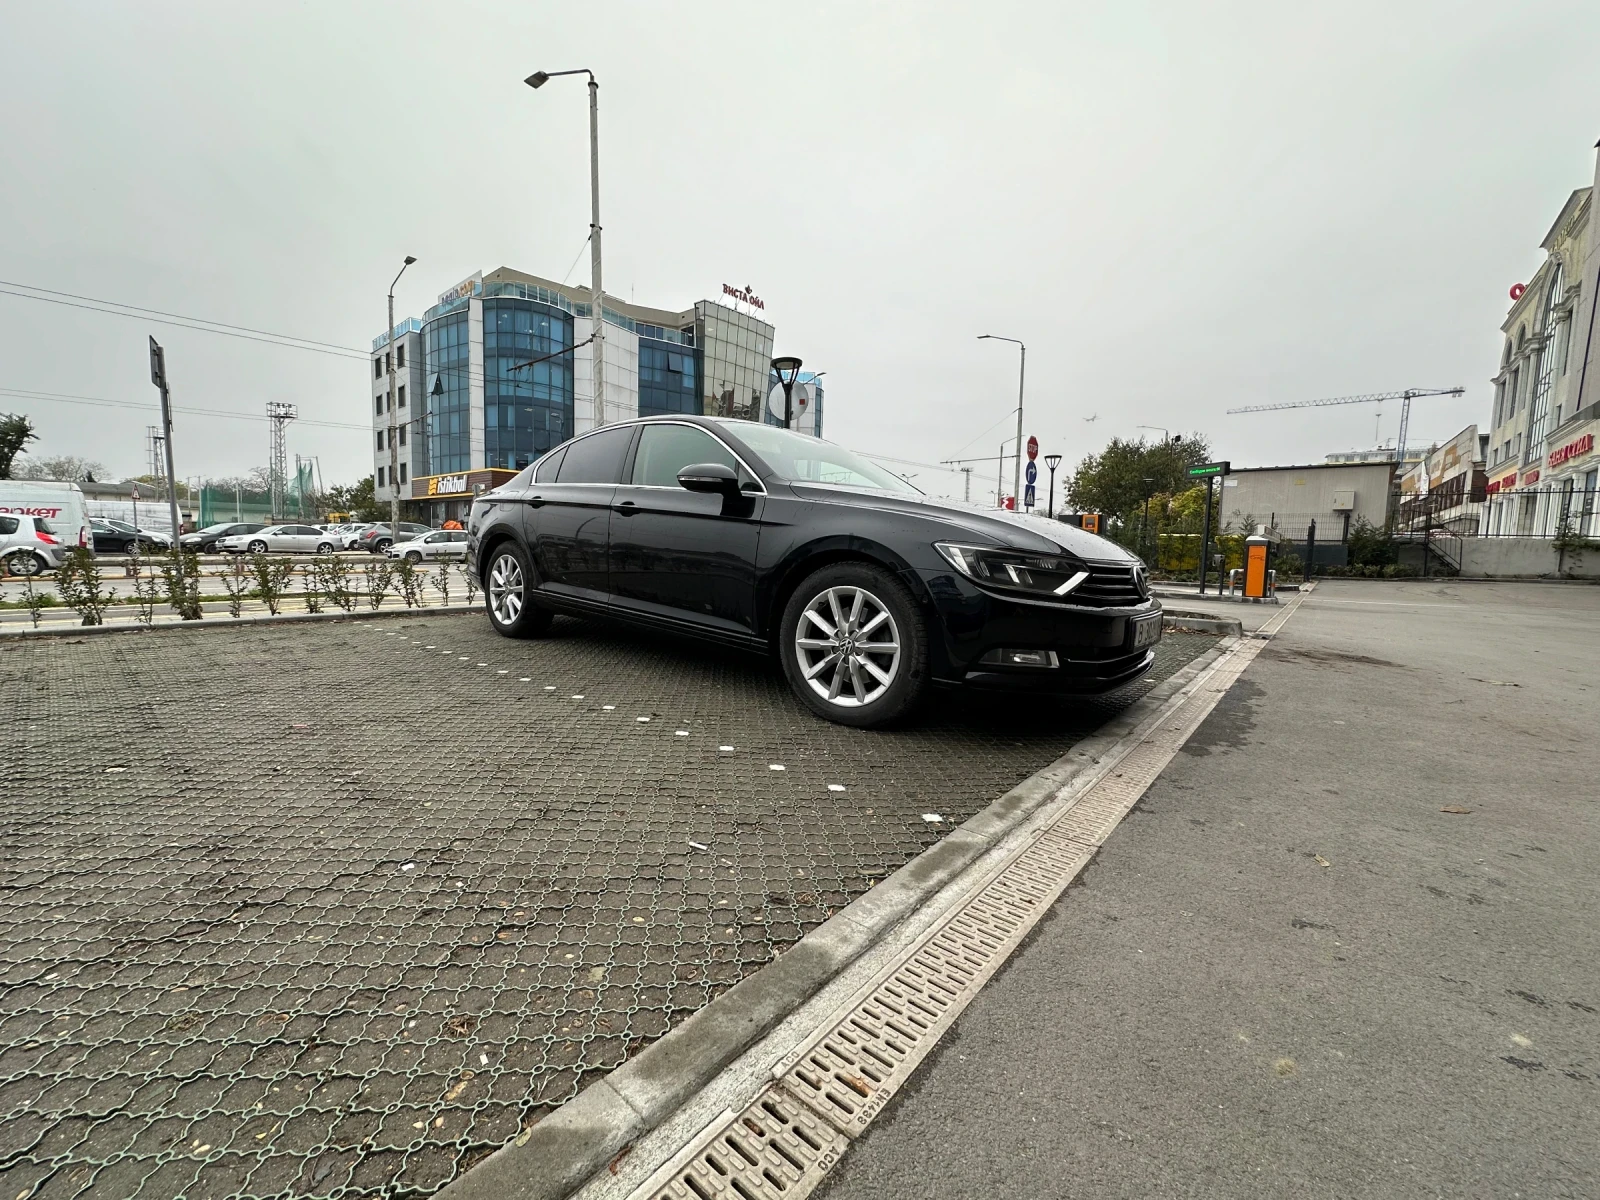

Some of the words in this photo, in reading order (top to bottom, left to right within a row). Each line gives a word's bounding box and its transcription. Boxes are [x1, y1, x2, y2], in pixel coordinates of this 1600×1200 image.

[722, 283, 748, 303] ВИСТА
[749, 295, 765, 310] ОЙЛ
[1028, 443, 1038, 453] STOP
[437, 475, 467, 493] istikbal
[780, 1051, 800, 1067] ACO
[818, 1146, 840, 1171] ACO
